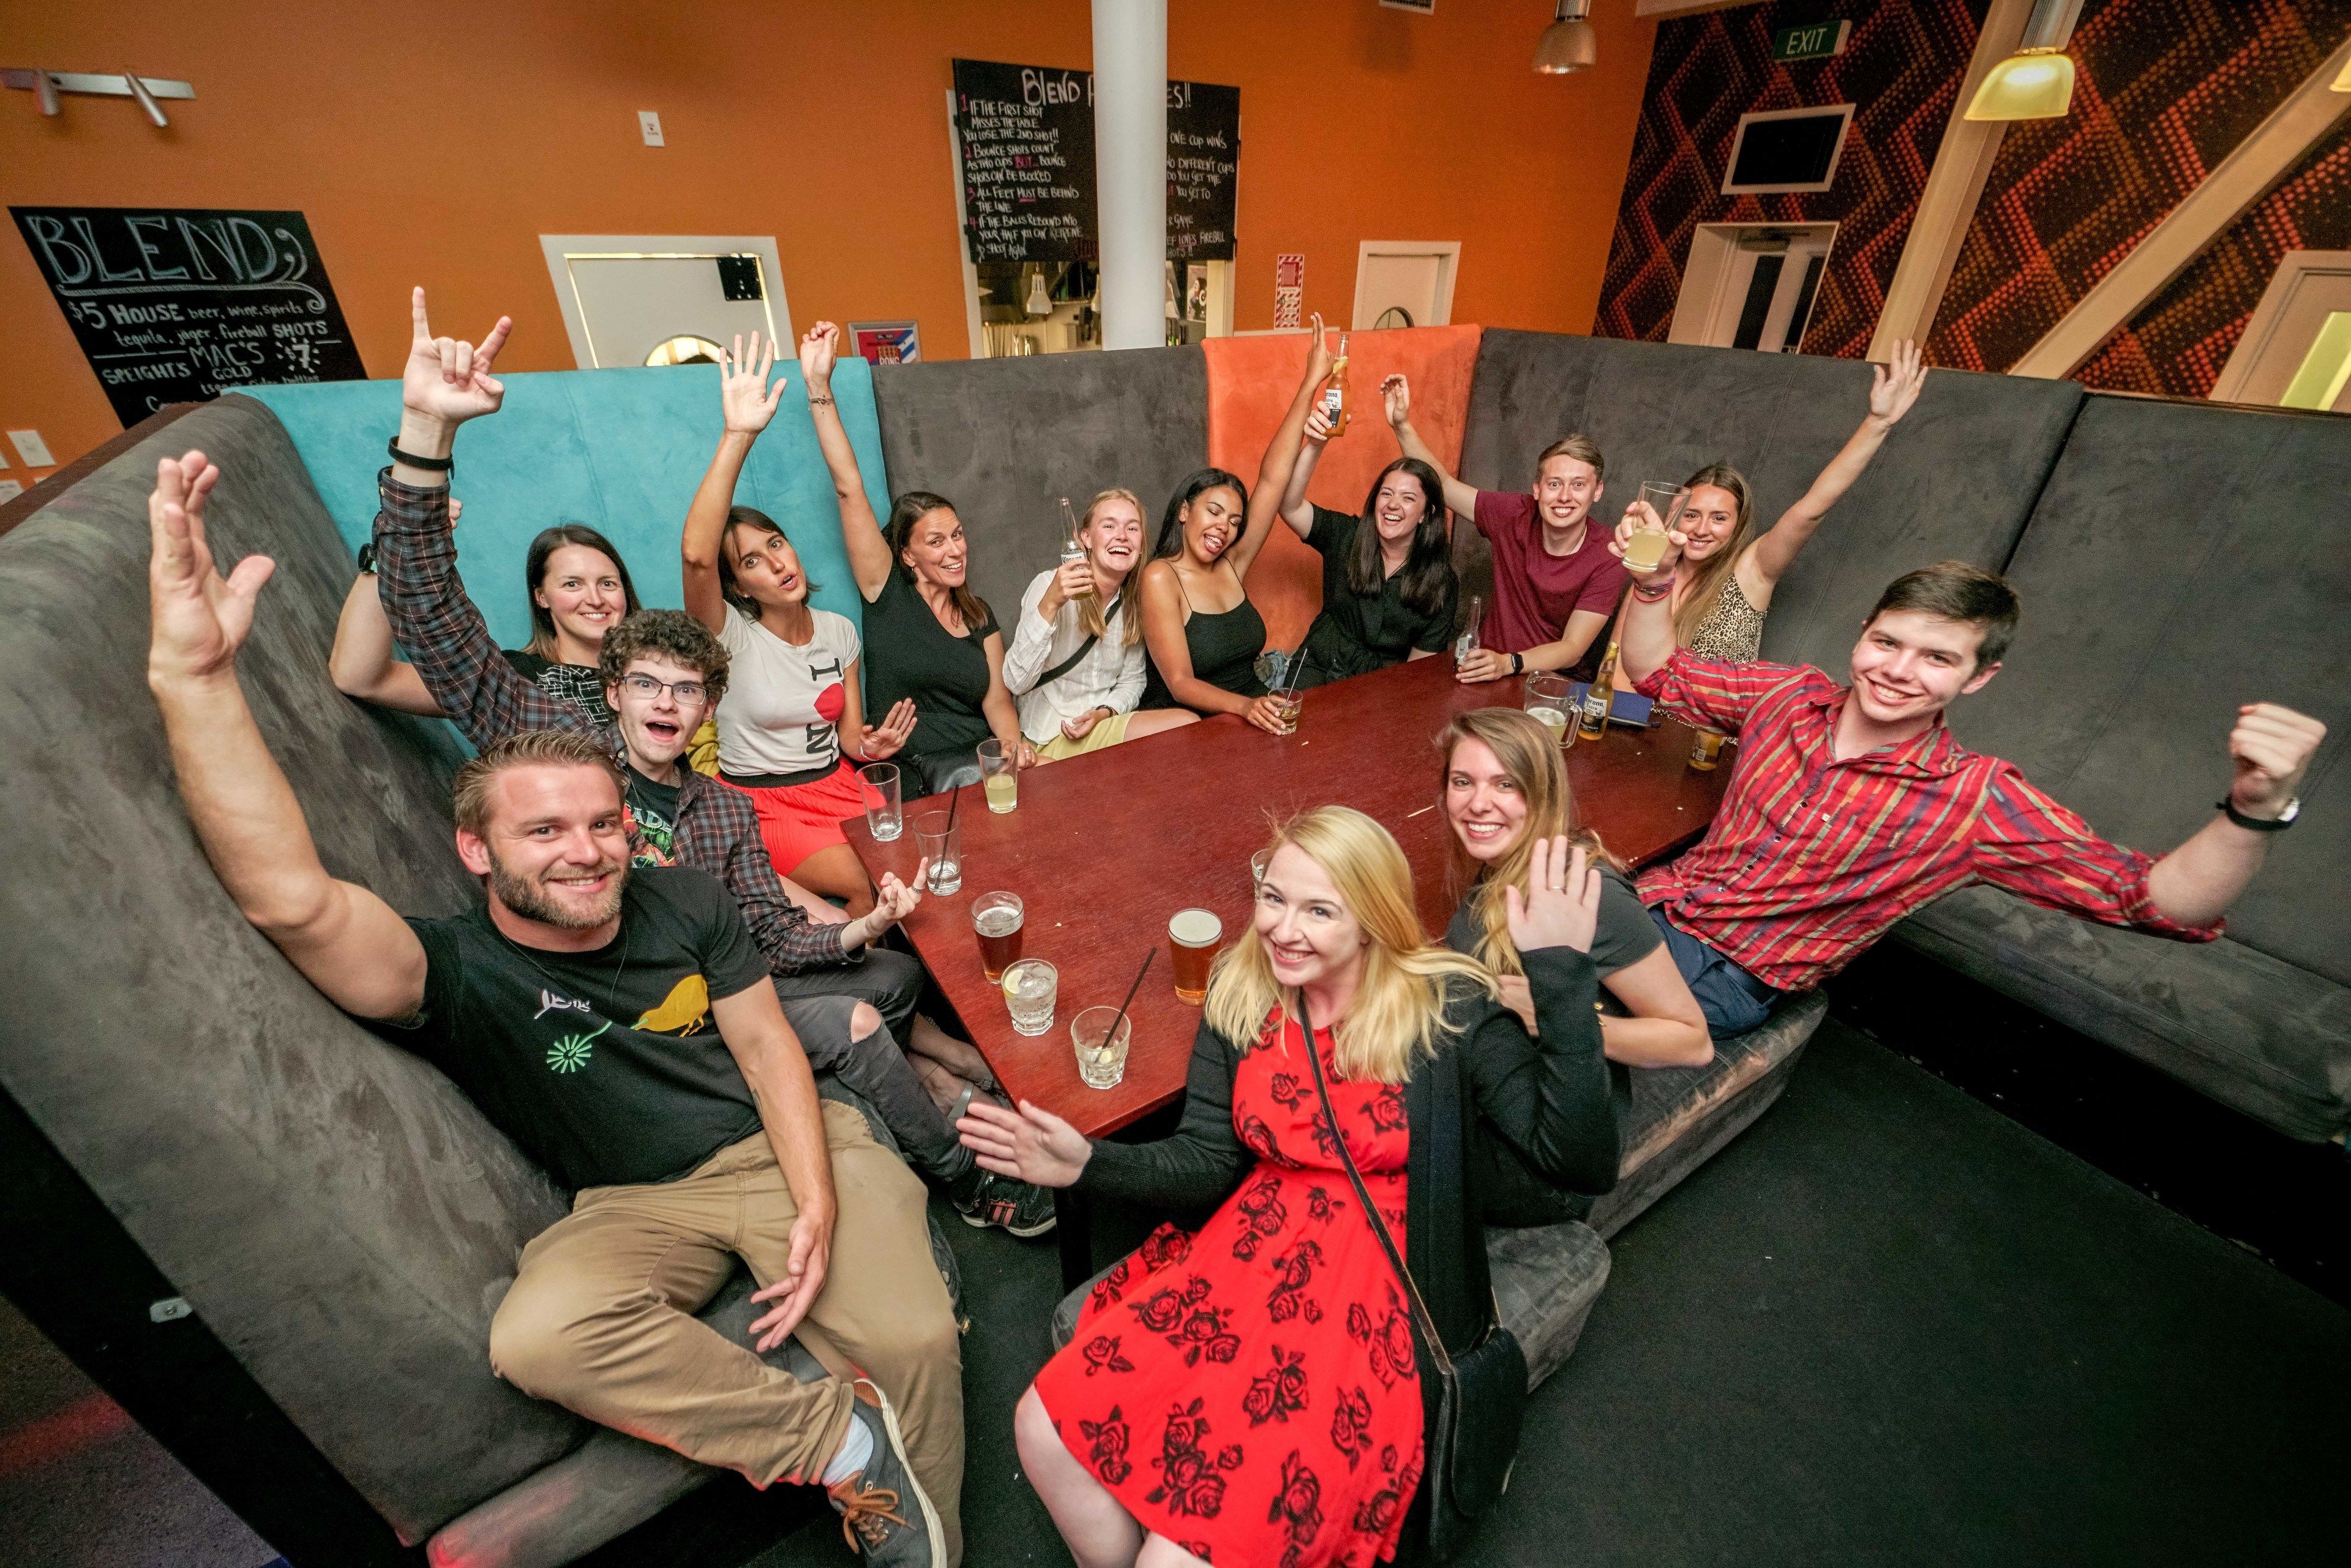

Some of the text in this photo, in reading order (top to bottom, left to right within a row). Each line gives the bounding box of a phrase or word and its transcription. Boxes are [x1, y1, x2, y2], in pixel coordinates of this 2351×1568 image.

[1787, 28, 1827, 54] EXIT
[970, 100, 980, 116] IF
[980, 100, 997, 116] THE
[998, 100, 1021, 117] FIRST
[1023, 105, 1043, 118] SHOT
[972, 117, 1001, 129] MISSES
[1000, 117, 1016, 128] THE
[963, 129, 977, 142] YOU
[999, 129, 1015, 139] THE
[1170, 130, 1187, 144] ONE
[992, 186, 1014, 200] FEET
[67, 300, 107, 329] $5
[107, 303, 185, 324] HOUSE
[272, 320, 328, 339] SHOTS
[212, 366, 253, 380] GOLD
[808, 658, 842, 681] I
